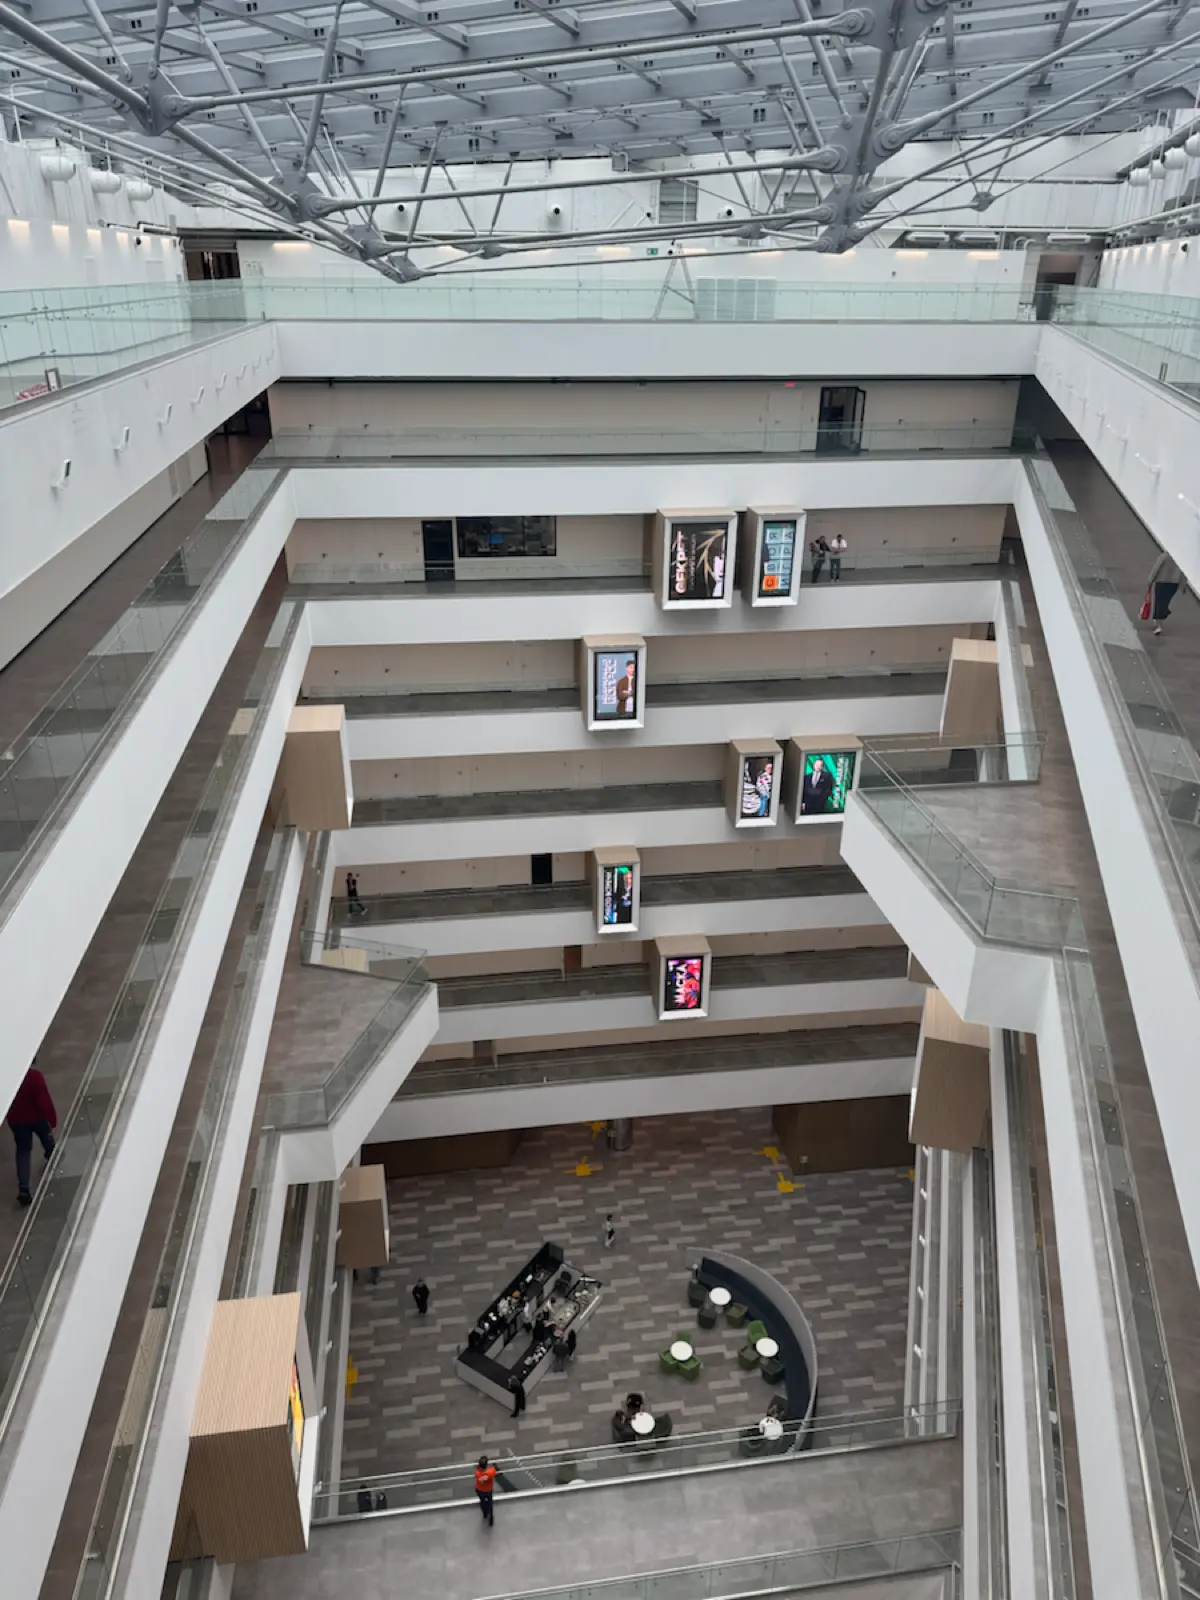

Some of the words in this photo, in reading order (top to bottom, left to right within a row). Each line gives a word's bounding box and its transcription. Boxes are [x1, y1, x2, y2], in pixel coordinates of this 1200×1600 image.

[675, 531, 687, 593] СЕКРЕТ
[766, 532, 777, 588] СВОЯ
[780, 532, 792, 586] ИГРА
[674, 964, 687, 1003] МАСКА
